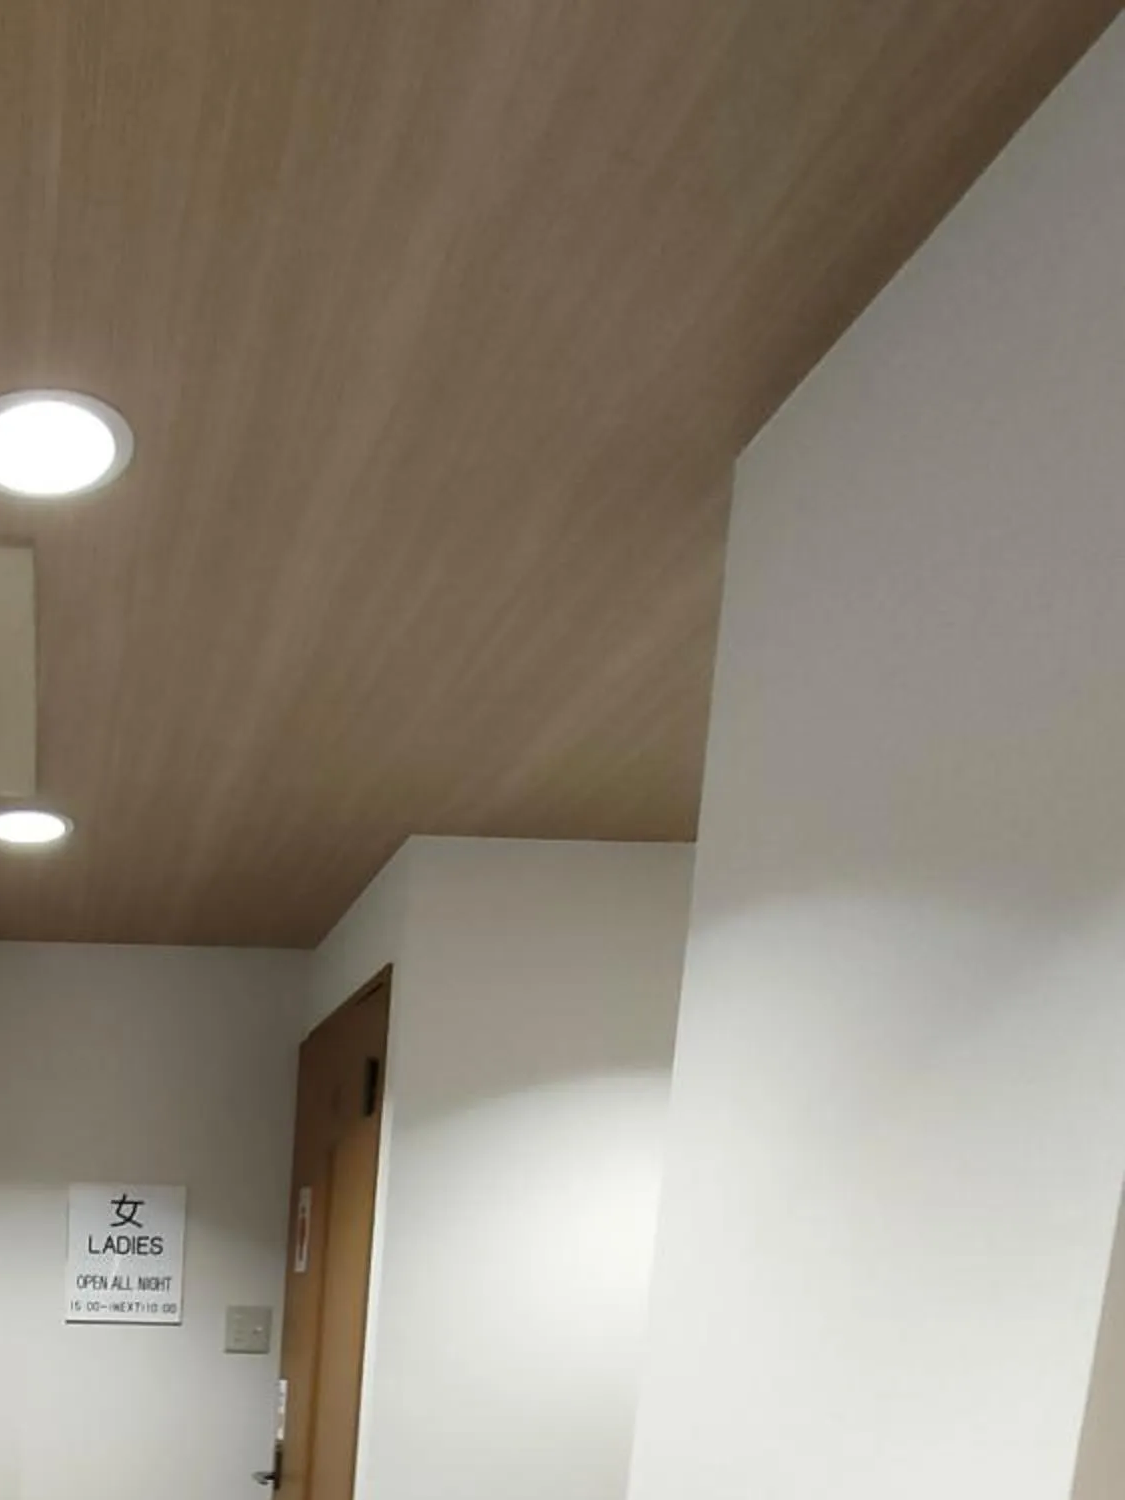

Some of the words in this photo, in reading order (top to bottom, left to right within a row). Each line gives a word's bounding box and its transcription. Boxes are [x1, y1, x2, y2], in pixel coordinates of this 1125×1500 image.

[110, 1193, 145, 1228] 女
[88, 1234, 164, 1255] LADIES
[76, 1273, 108, 1290] OPEN
[111, 1275, 132, 1291] ALL
[138, 1275, 171, 1292] NIGHT
